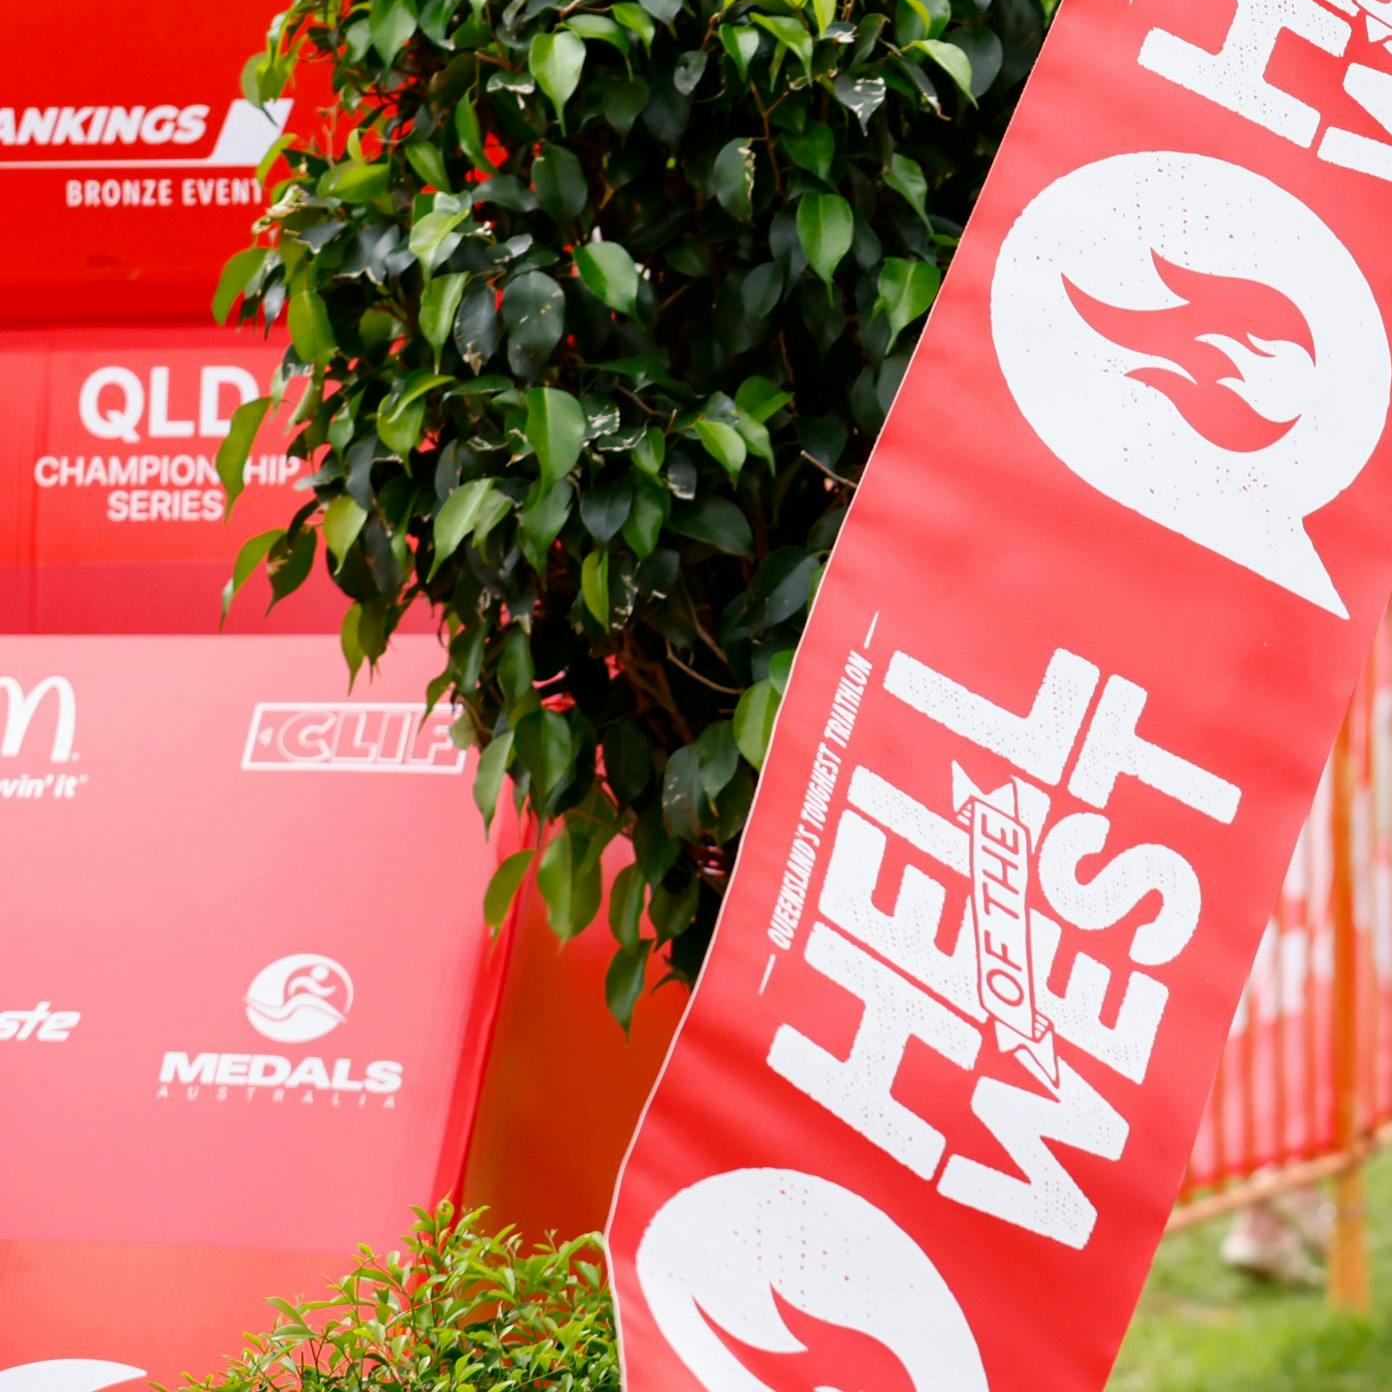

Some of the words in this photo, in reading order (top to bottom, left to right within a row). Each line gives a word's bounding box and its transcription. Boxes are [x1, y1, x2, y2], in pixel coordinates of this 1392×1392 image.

[65, 179, 173, 208] BRONZE
[182, 177, 262, 206] EVENT
[78, 365, 261, 444] QLD
[33, 455, 301, 489] CHAMPIONHIP
[106, 490, 224, 523] SERIES
[767, 822, 821, 950] QUEENSLAND'S
[801, 741, 842, 831] TOUGHEST
[823, 649, 873, 749] TRIATHLON
[981, 812, 1020, 920] THE
[766, 647, 1100, 1181] HELL
[936, 674, 1241, 1249] WEST
[984, 929, 1024, 1007] OF
[156, 1085, 397, 1110] AUSTRALIA
[158, 1051, 404, 1094] MEDALS
